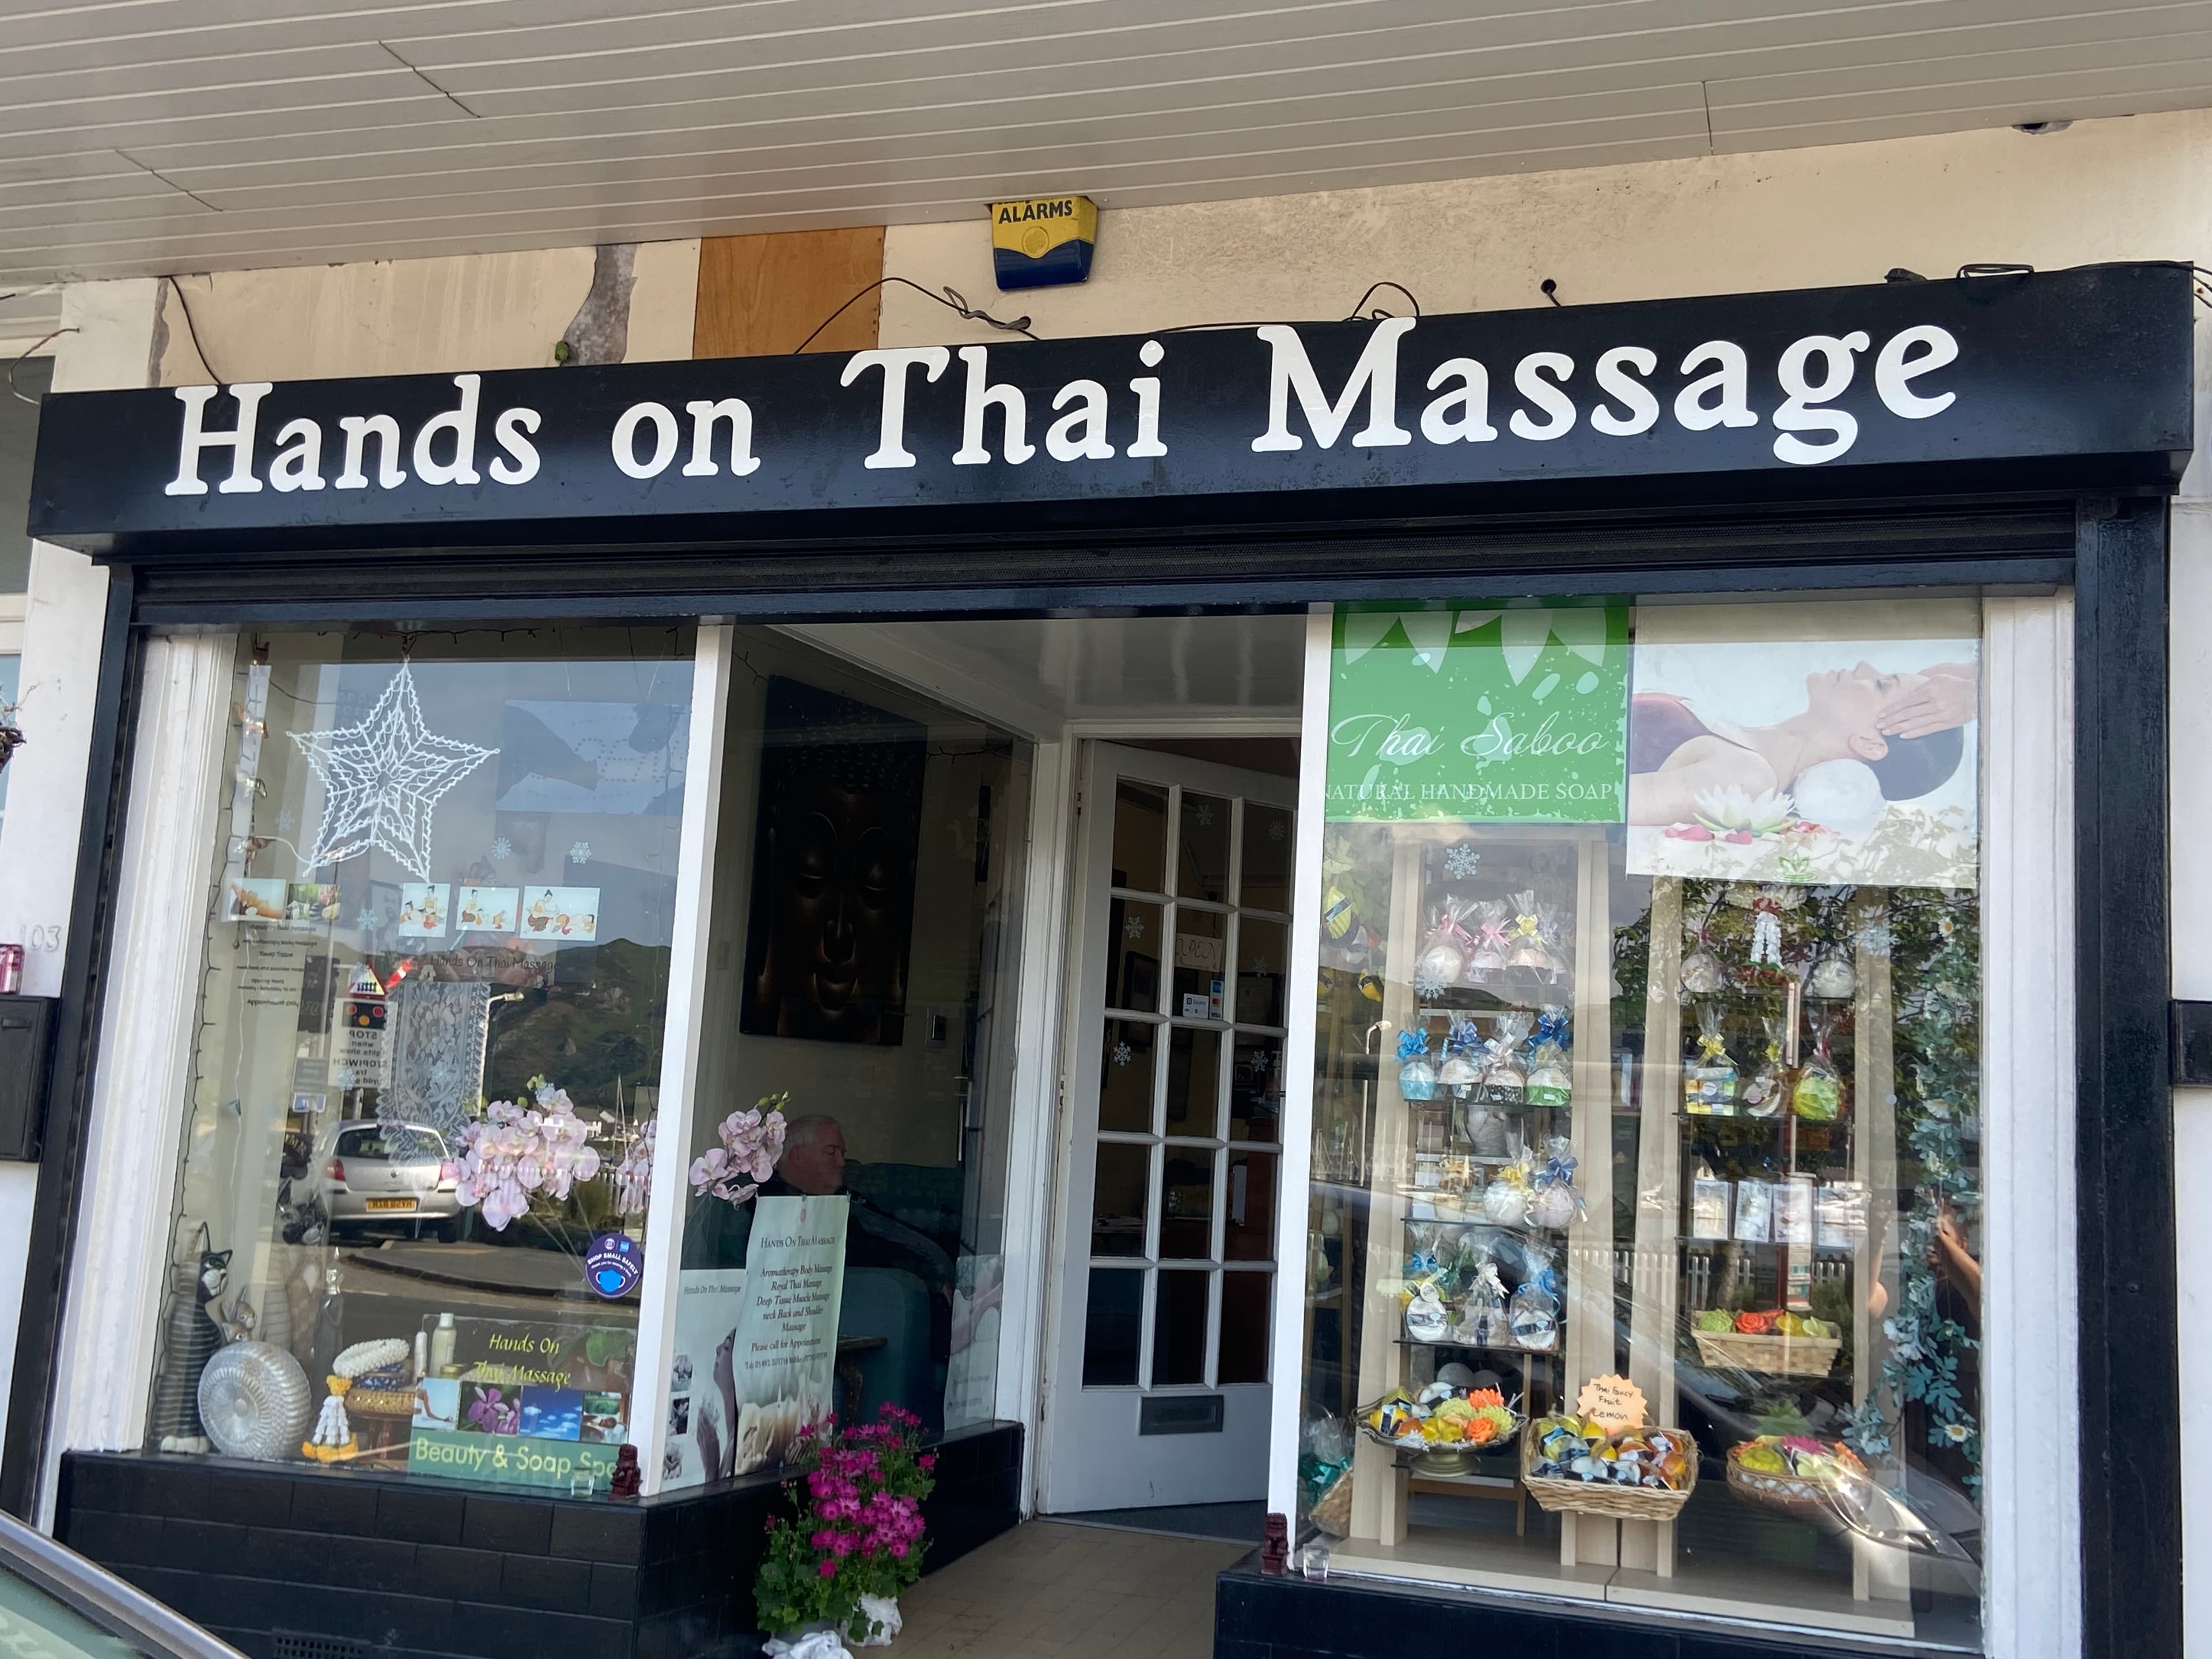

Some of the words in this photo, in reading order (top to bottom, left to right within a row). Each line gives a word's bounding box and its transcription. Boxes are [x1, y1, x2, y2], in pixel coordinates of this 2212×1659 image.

[998, 200, 1073, 224] ALARMS
[164, 373, 541, 496] Hands
[612, 397, 762, 479] on
[840, 339, 1168, 469] Thai
[1251, 317, 1959, 465] Massage
[1330, 713, 1445, 758] Thai
[1460, 711, 1611, 756] Saboo
[1421, 783, 1551, 800] HANDMADE
[1555, 783, 1612, 800] SOAP
[430, 954, 464, 967] Hands
[467, 955, 483, 968] On
[484, 955, 510, 968] Thai
[588, 1253, 603, 1265] SHOP
[603, 1252, 621, 1261] SMALL
[622, 1256, 639, 1275] SAFELY
[756, 1296, 772, 1308] Deep
[793, 1307, 805, 1317] and
[488, 1333, 535, 1354] Hands
[540, 1338, 560, 1354] On
[751, 1342, 768, 1352] Please
[770, 1339, 779, 1350] call
[780, 1340, 788, 1349] for
[473, 1359, 505, 1379] Thai
[510, 1365, 571, 1392] Massage
[1593, 1383, 1610, 1393] Thai
[1599, 1395, 1623, 1406] Fruit
[415, 1437, 488, 1472] Beauty
[493, 1444, 509, 1469] &
[517, 1446, 571, 1479] Soap
